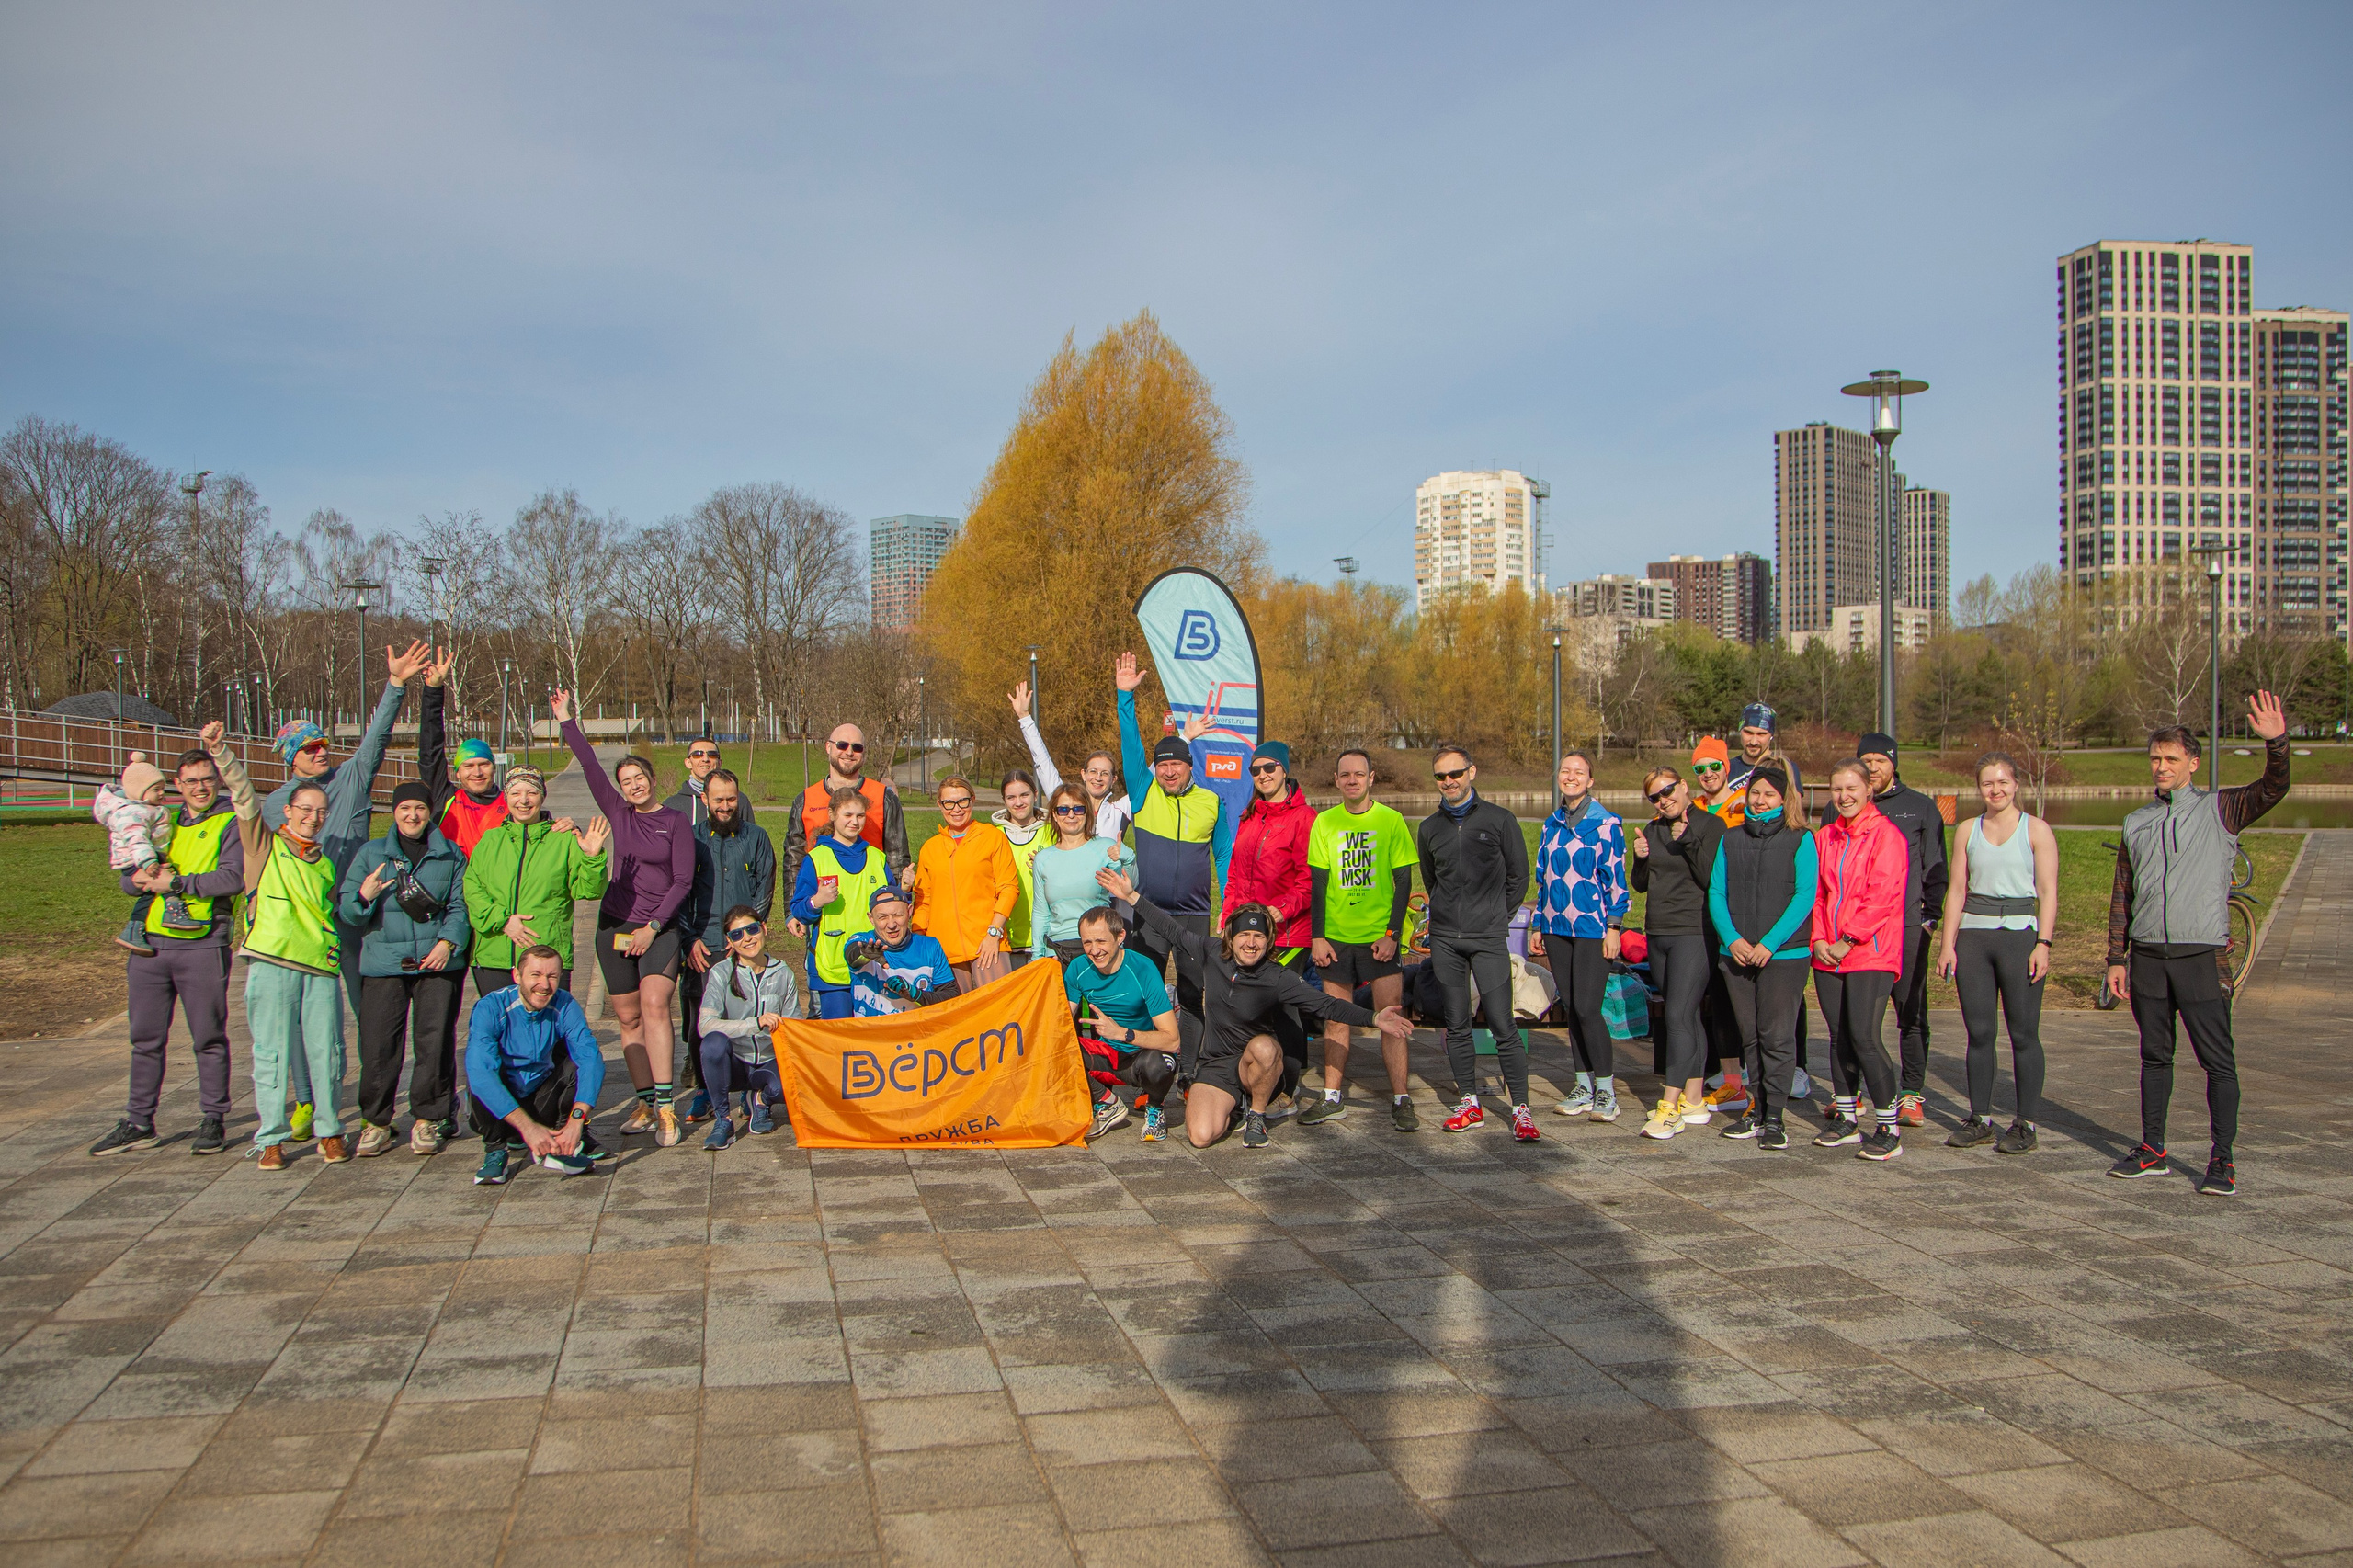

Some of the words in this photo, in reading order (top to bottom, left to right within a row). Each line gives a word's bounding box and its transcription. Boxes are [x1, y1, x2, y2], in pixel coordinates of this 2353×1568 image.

[1346, 832, 1369, 849] WE
[1342, 850, 1371, 868] RUN
[1342, 869, 1371, 886] MSK
